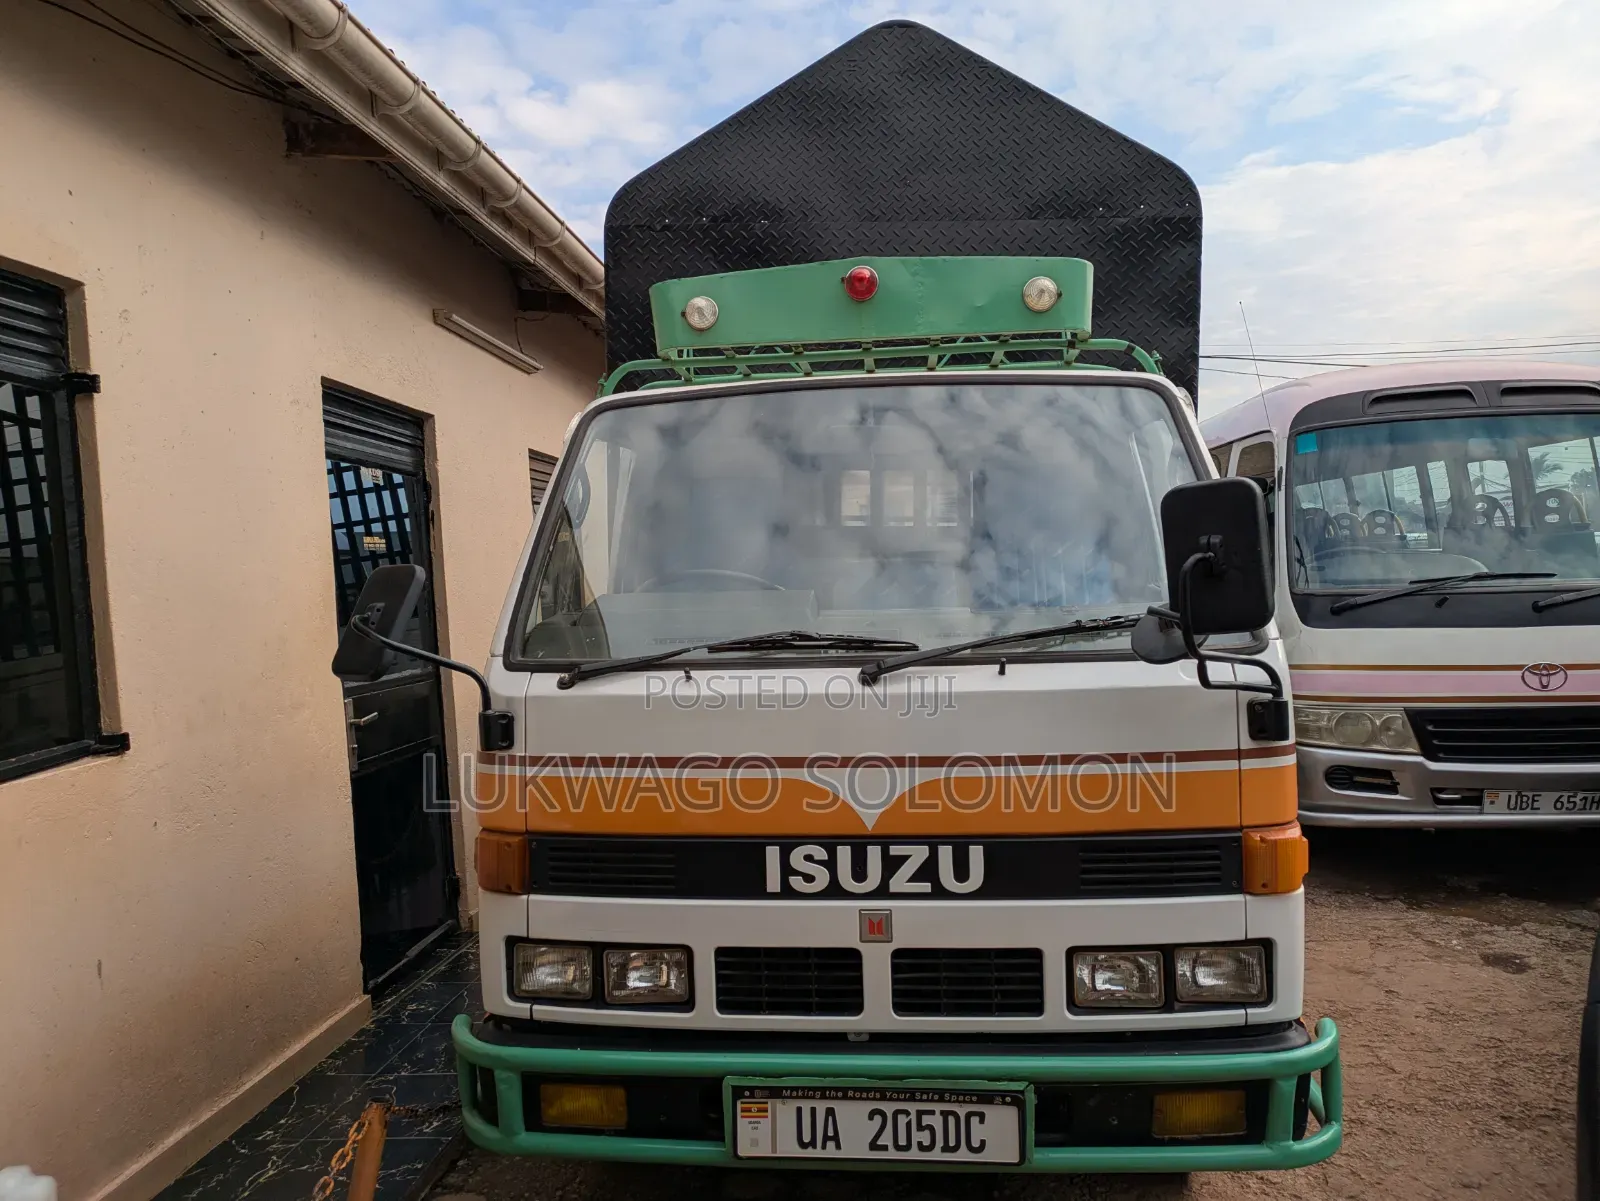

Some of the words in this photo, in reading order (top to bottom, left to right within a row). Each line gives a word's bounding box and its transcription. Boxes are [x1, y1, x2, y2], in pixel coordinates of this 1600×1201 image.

[1506, 793, 1542, 811] UBE
[765, 844, 985, 894] ISUZU
[782, 1089, 821, 1099] Making
[825, 1089, 843, 1098] the
[847, 1089, 881, 1099] Roads
[885, 1090, 911, 1100] Your
[915, 1091, 939, 1101] Safe
[944, 1092, 978, 1103] Space
[795, 1105, 842, 1151] UA
[867, 1107, 987, 1154] 205DC
